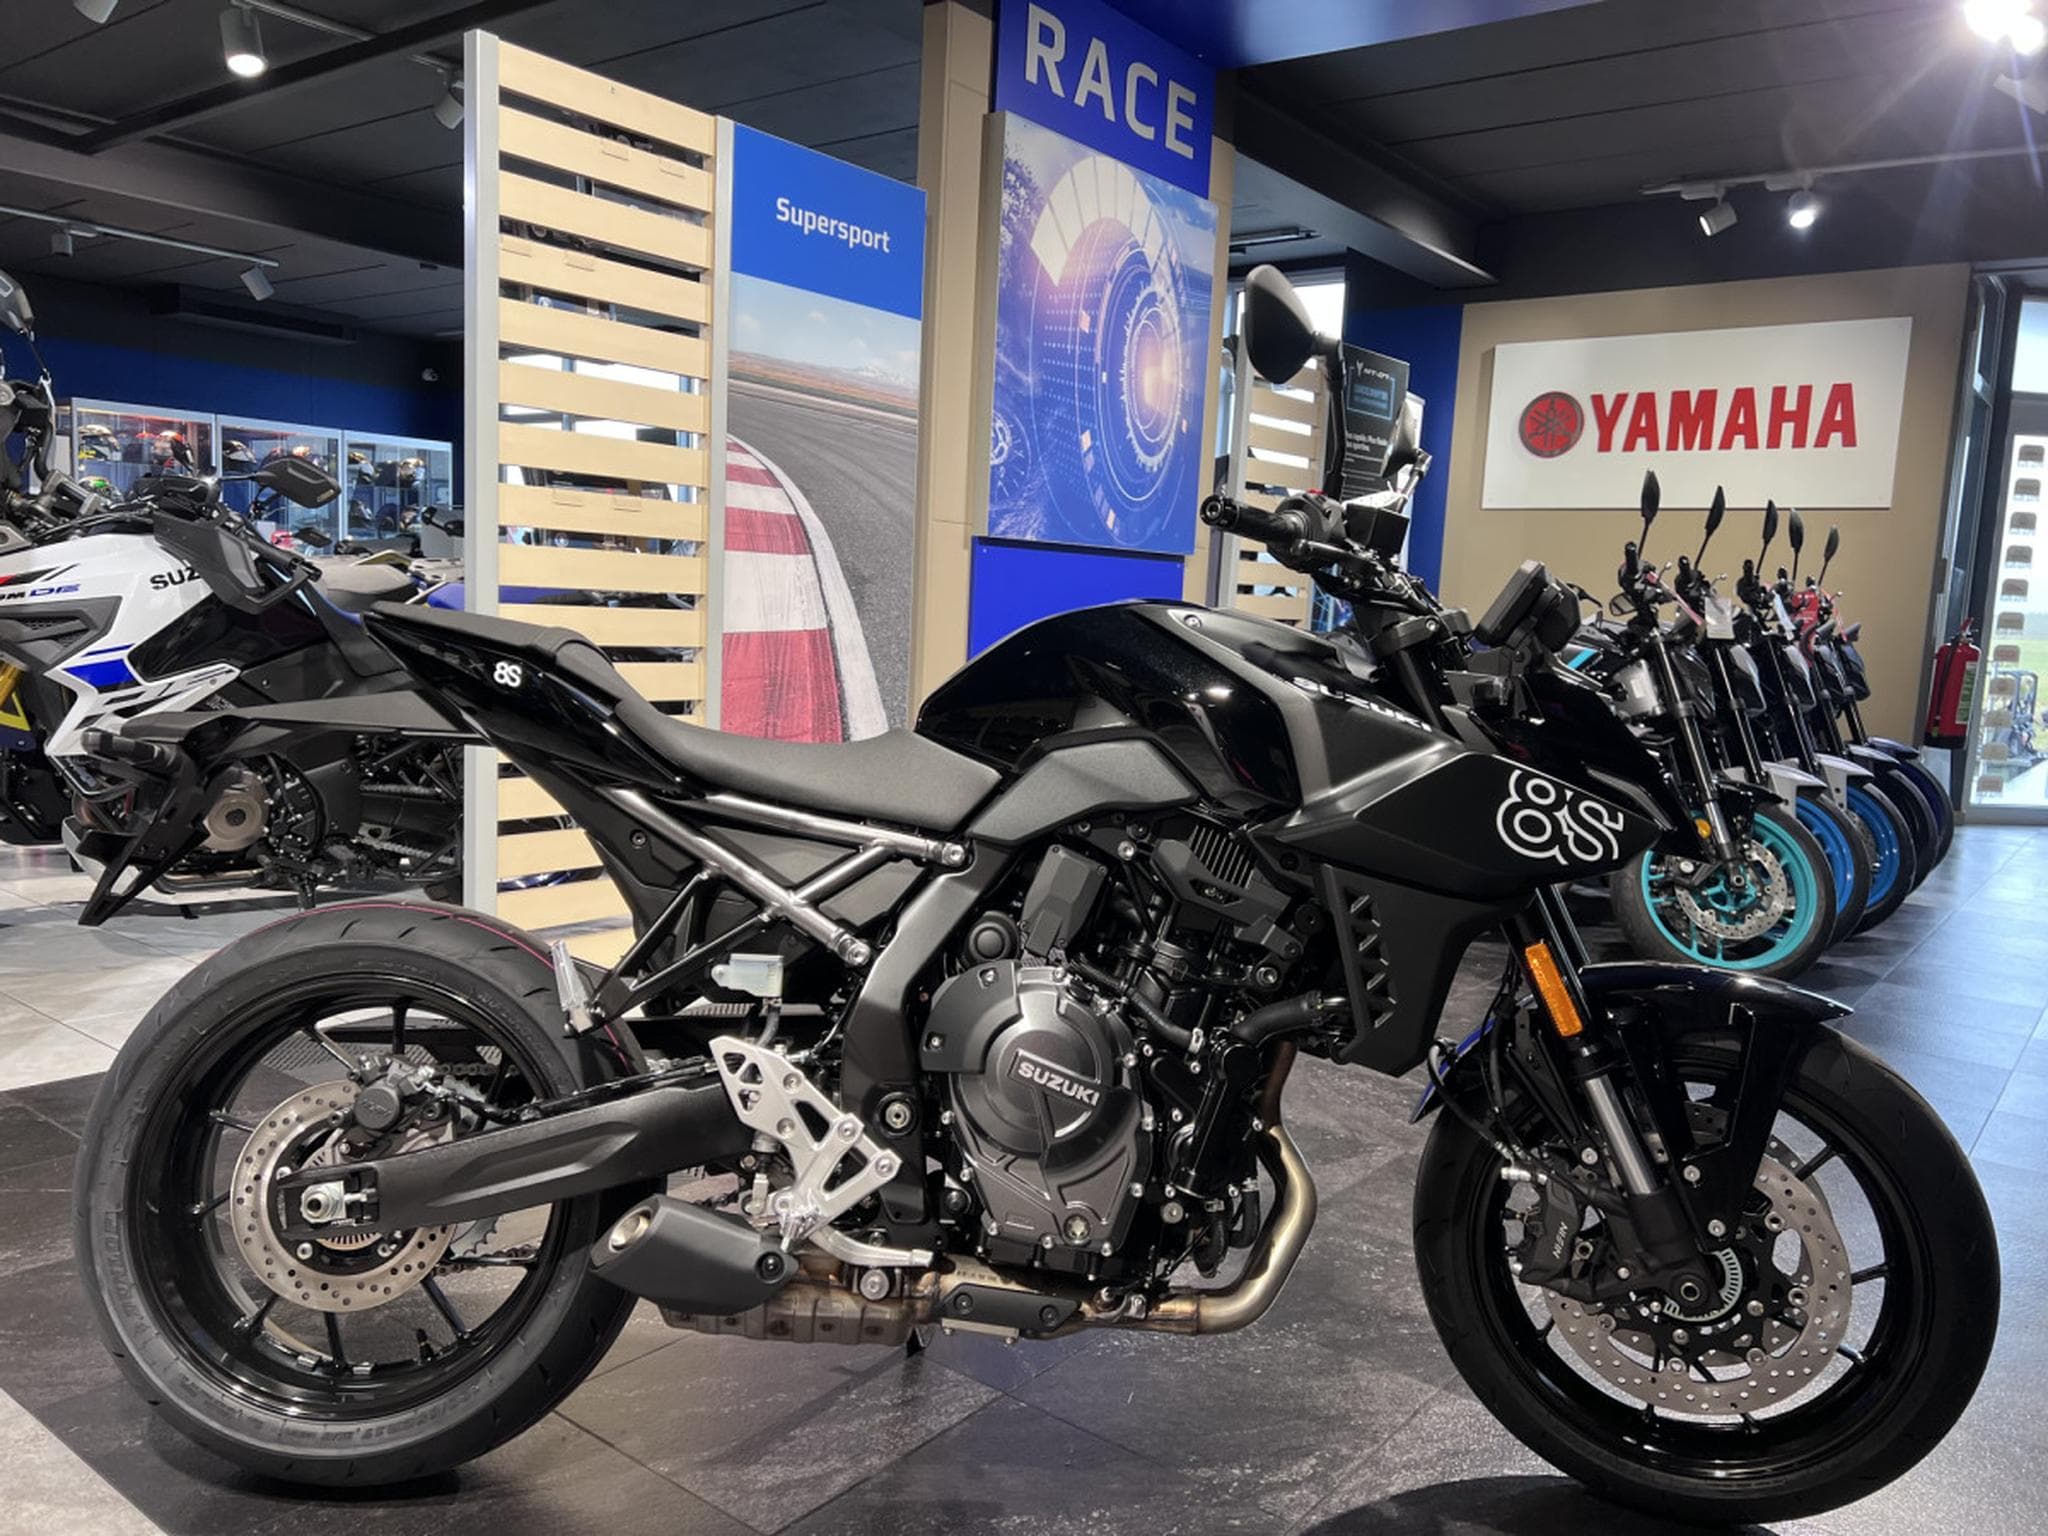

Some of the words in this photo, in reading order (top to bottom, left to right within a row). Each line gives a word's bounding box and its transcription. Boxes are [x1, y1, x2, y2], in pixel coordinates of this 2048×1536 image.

[1025, 2, 1197, 160] RACE
[776, 197, 891, 254] Supersport
[1590, 382, 1858, 453] YAMAHA
[493, 661, 522, 687] 8S
[1018, 1061, 1100, 1106] SUZUKI
